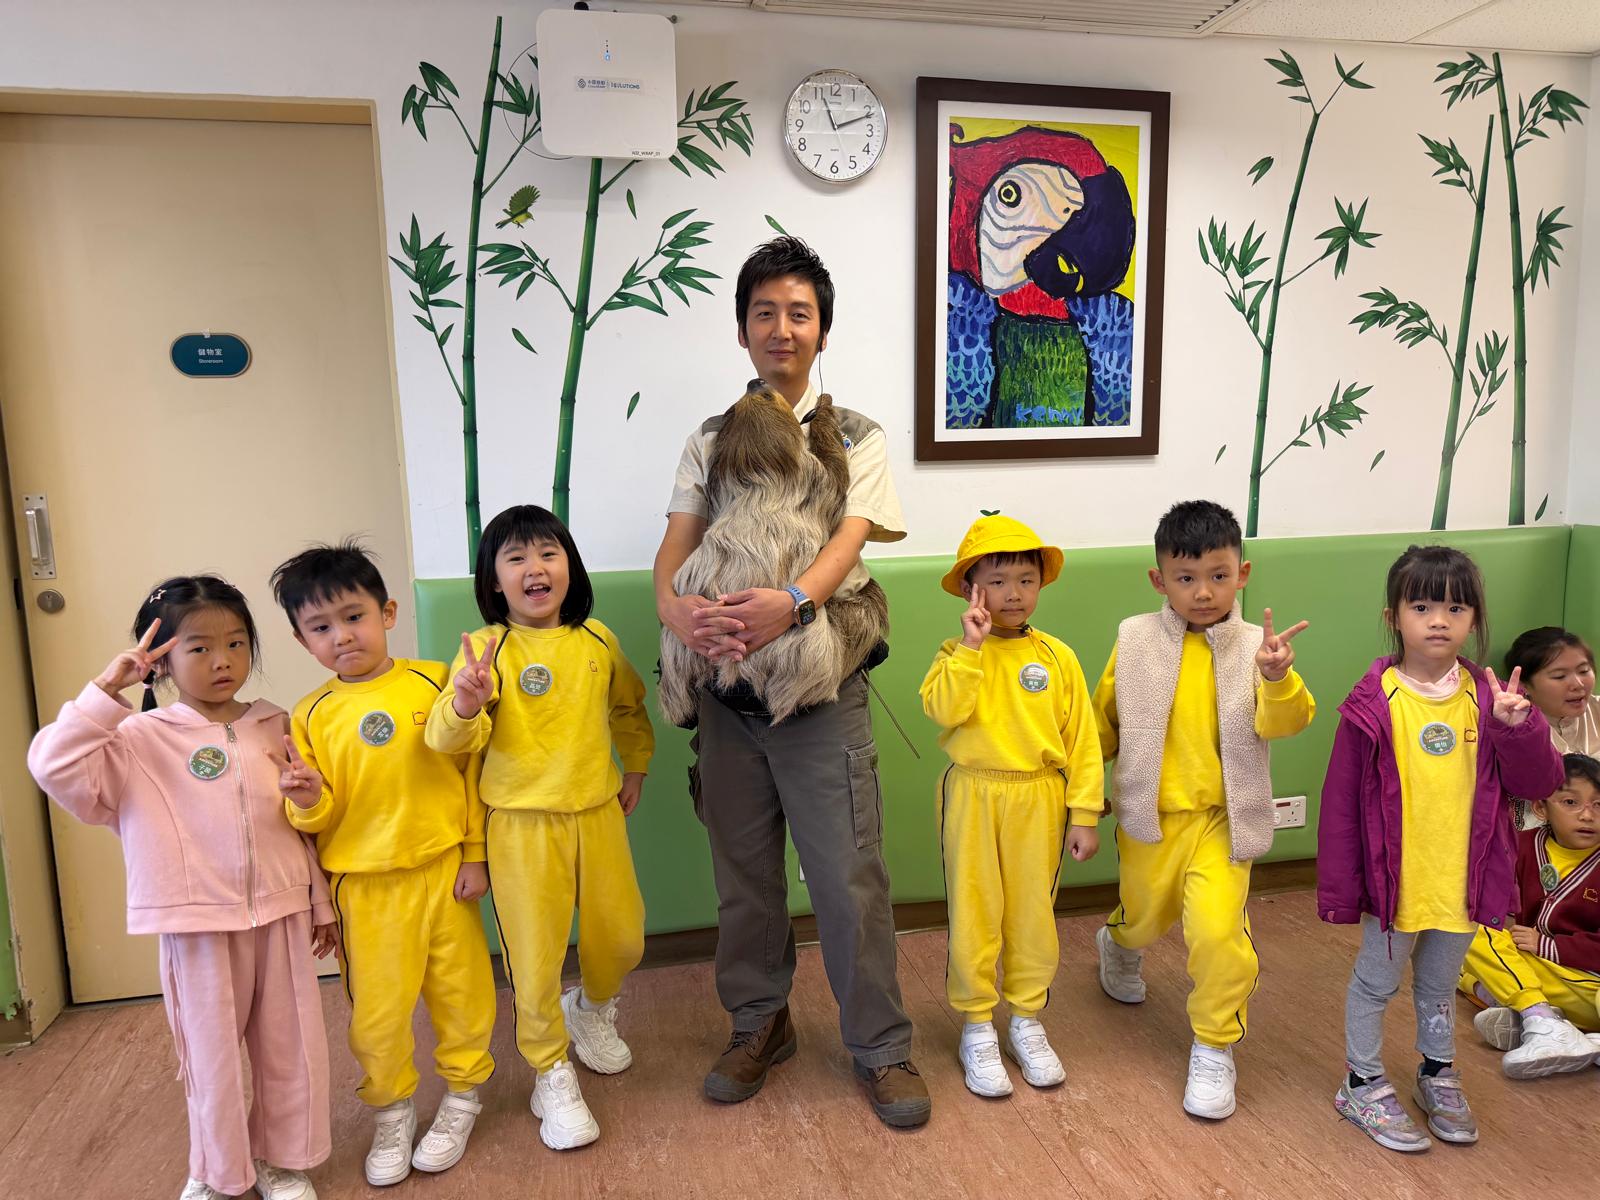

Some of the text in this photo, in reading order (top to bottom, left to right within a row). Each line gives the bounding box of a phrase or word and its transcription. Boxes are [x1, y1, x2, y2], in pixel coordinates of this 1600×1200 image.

[814, 86, 824, 101] 11
[830, 82, 842, 97] 12
[799, 99, 811, 114] 10
[863, 104, 872, 119] 2
[795, 118, 804, 133] 9
[865, 123, 874, 138] 3
[797, 137, 807, 152] 8
[862, 142, 871, 155] 4
[813, 153, 822, 168] 7
[829, 160, 839, 174] 6
[848, 155, 857, 170] 5
